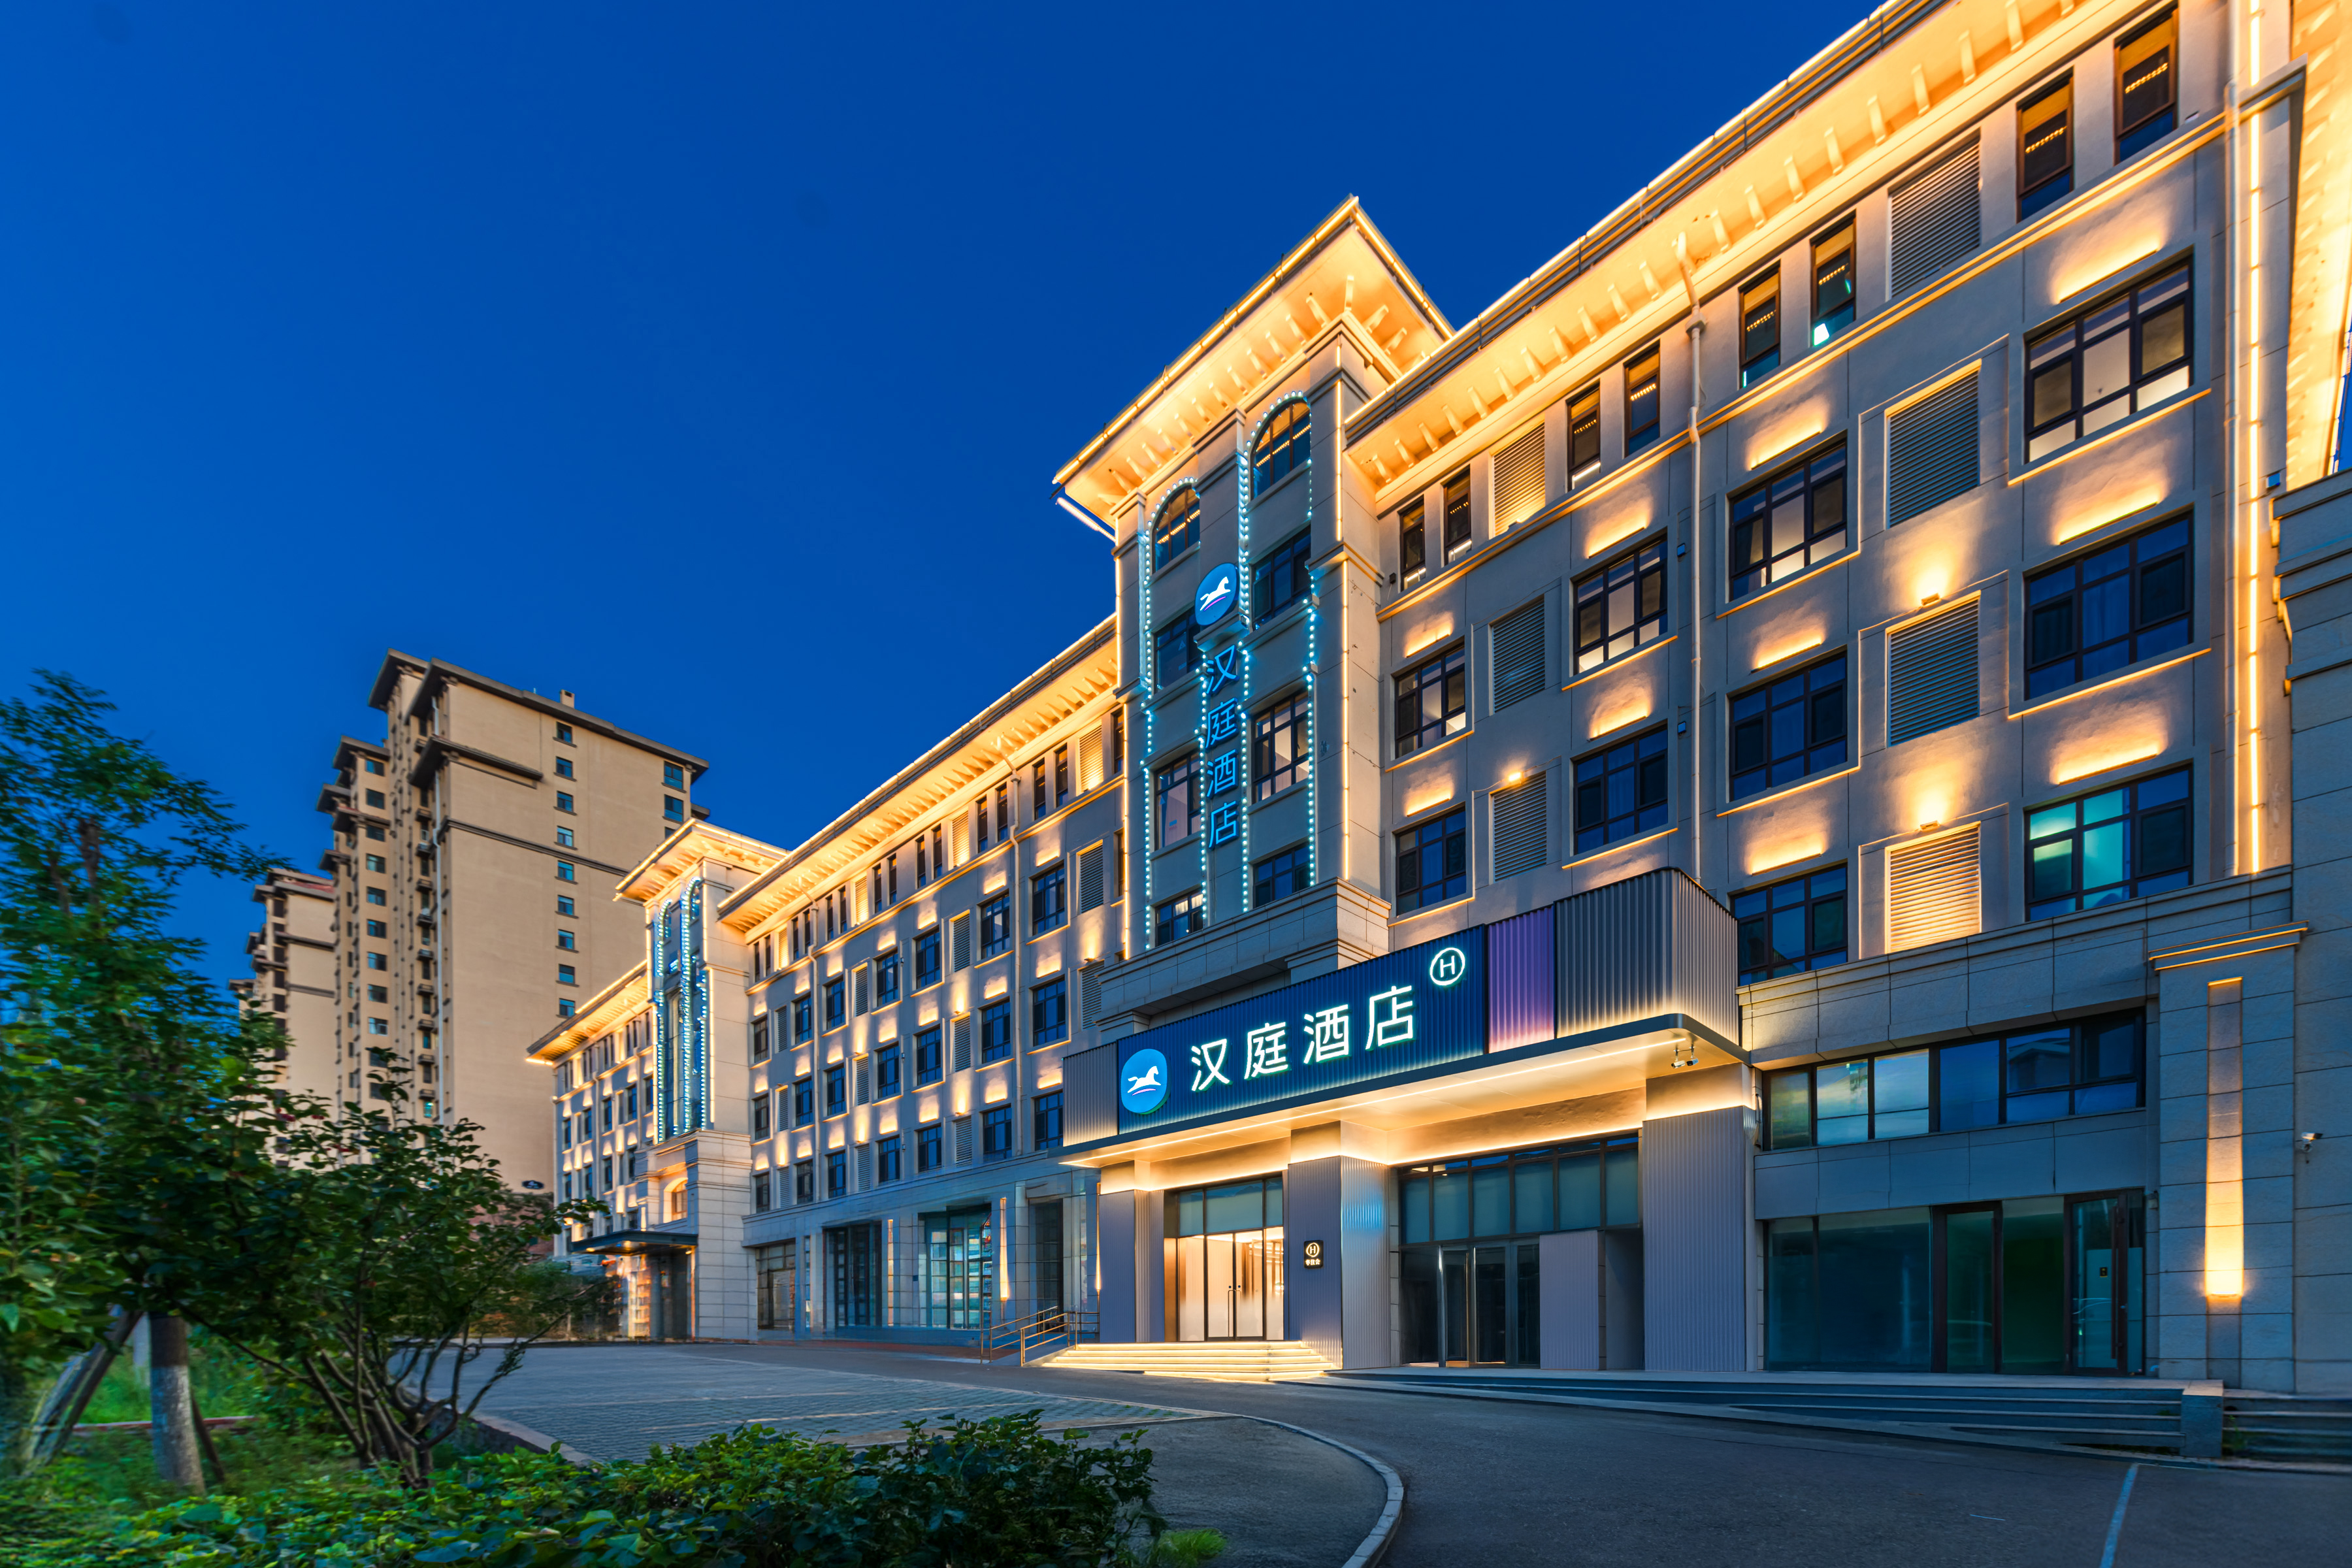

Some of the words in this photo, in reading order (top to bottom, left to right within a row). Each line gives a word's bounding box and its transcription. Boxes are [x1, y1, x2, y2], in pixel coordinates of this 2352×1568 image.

[1205, 644, 1239, 848] 汉庭酒店
[1191, 985, 1414, 1092] 汉庭酒店
